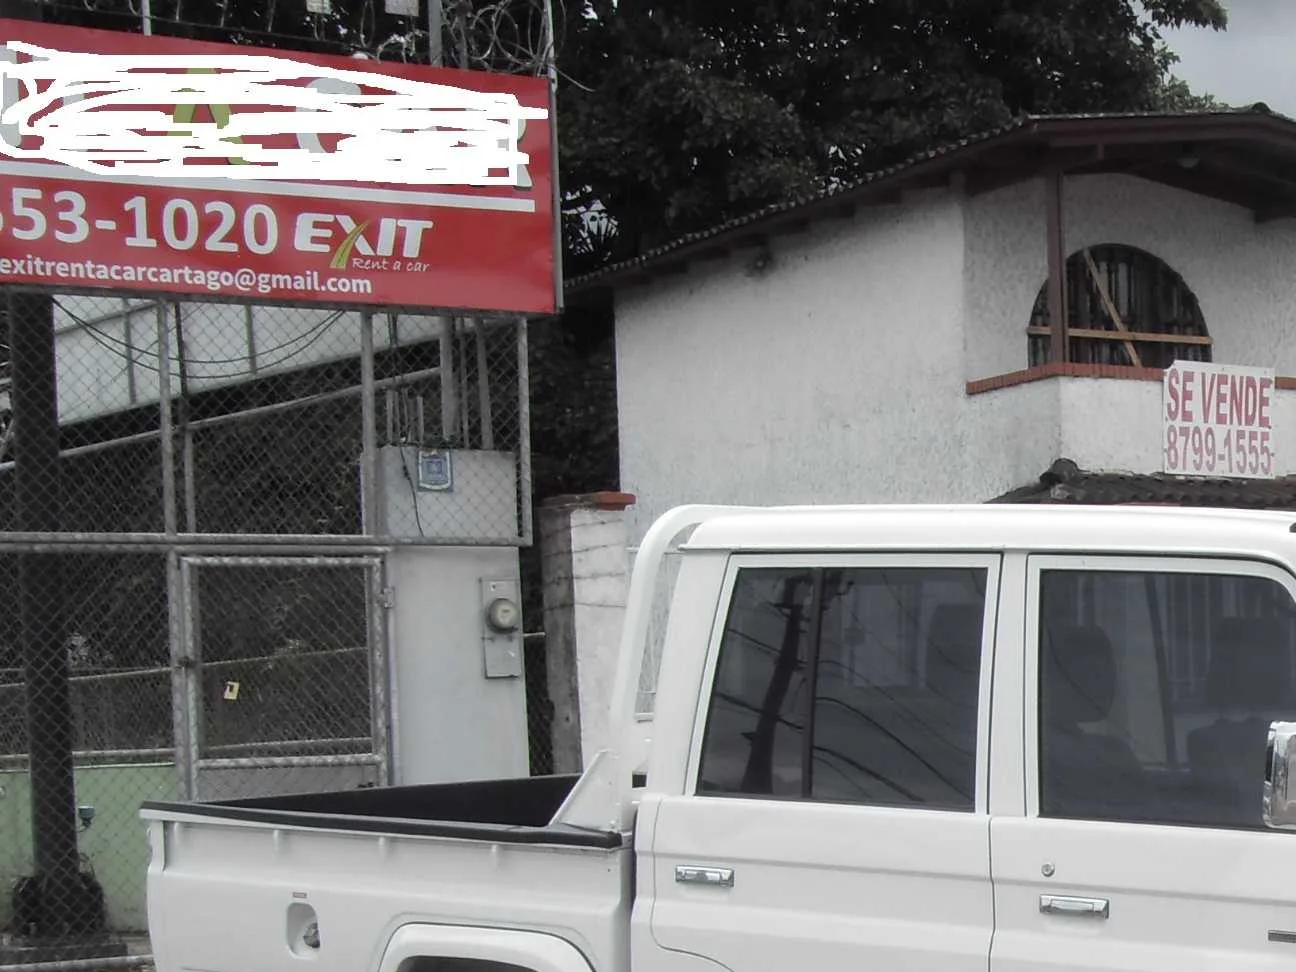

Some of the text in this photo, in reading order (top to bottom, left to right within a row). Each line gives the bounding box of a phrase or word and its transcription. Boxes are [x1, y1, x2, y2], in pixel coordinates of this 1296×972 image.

[0, 187, 279, 255] 53-1020
[294, 212, 434, 268] EXIT
[0, 254, 373, 294] exitrentacarcartago@gmail.com
[352, 257, 431, 272] Rent a car
[1166, 368, 1273, 429] SE VENDE
[1166, 425, 1272, 475] 8799-1555
